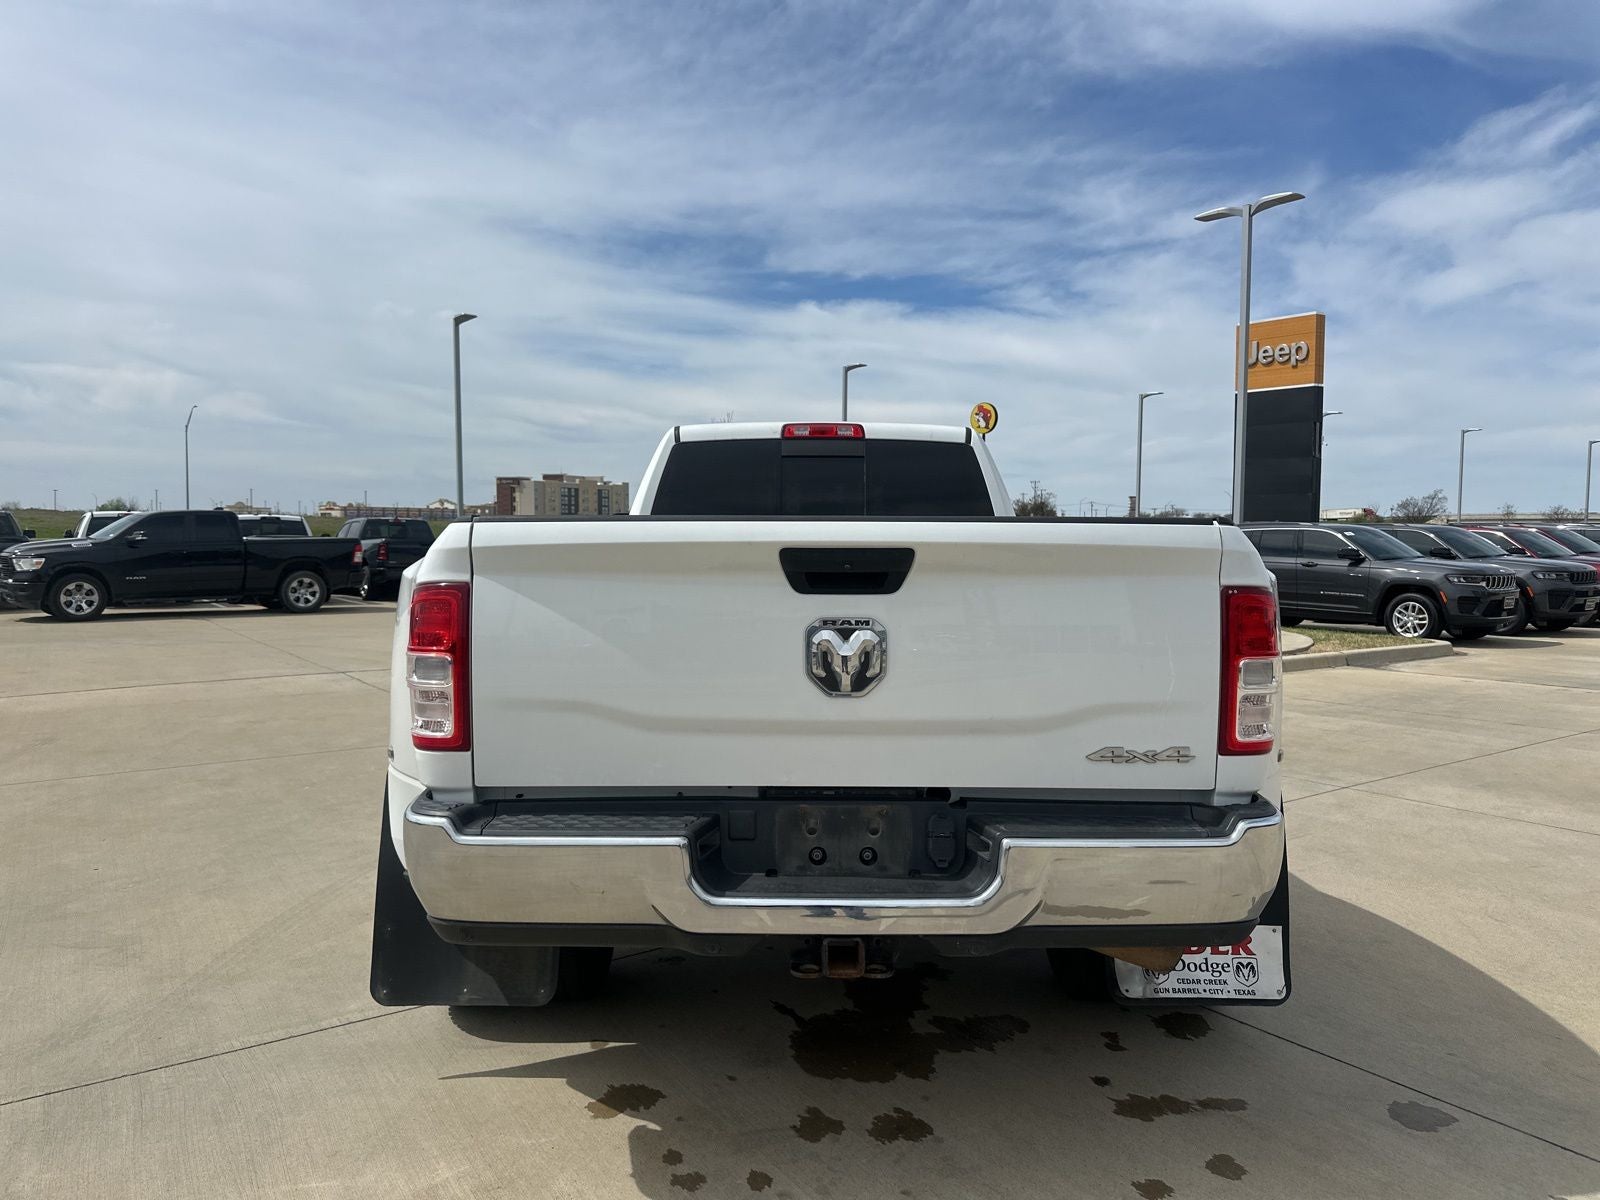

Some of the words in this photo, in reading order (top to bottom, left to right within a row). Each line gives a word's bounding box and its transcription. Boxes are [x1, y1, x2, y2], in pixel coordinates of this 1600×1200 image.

[1247, 340, 1309, 368] Jeep
[822, 619, 871, 627] RAM
[1085, 746, 1196, 764] 4x4
[1176, 977, 1202, 985] CEDAR
[1203, 978, 1229, 986] CREEK
[1153, 987, 1171, 995] GUN
[1171, 987, 1202, 995] BARREL
[1233, 988, 1257, 996] TEXAS
